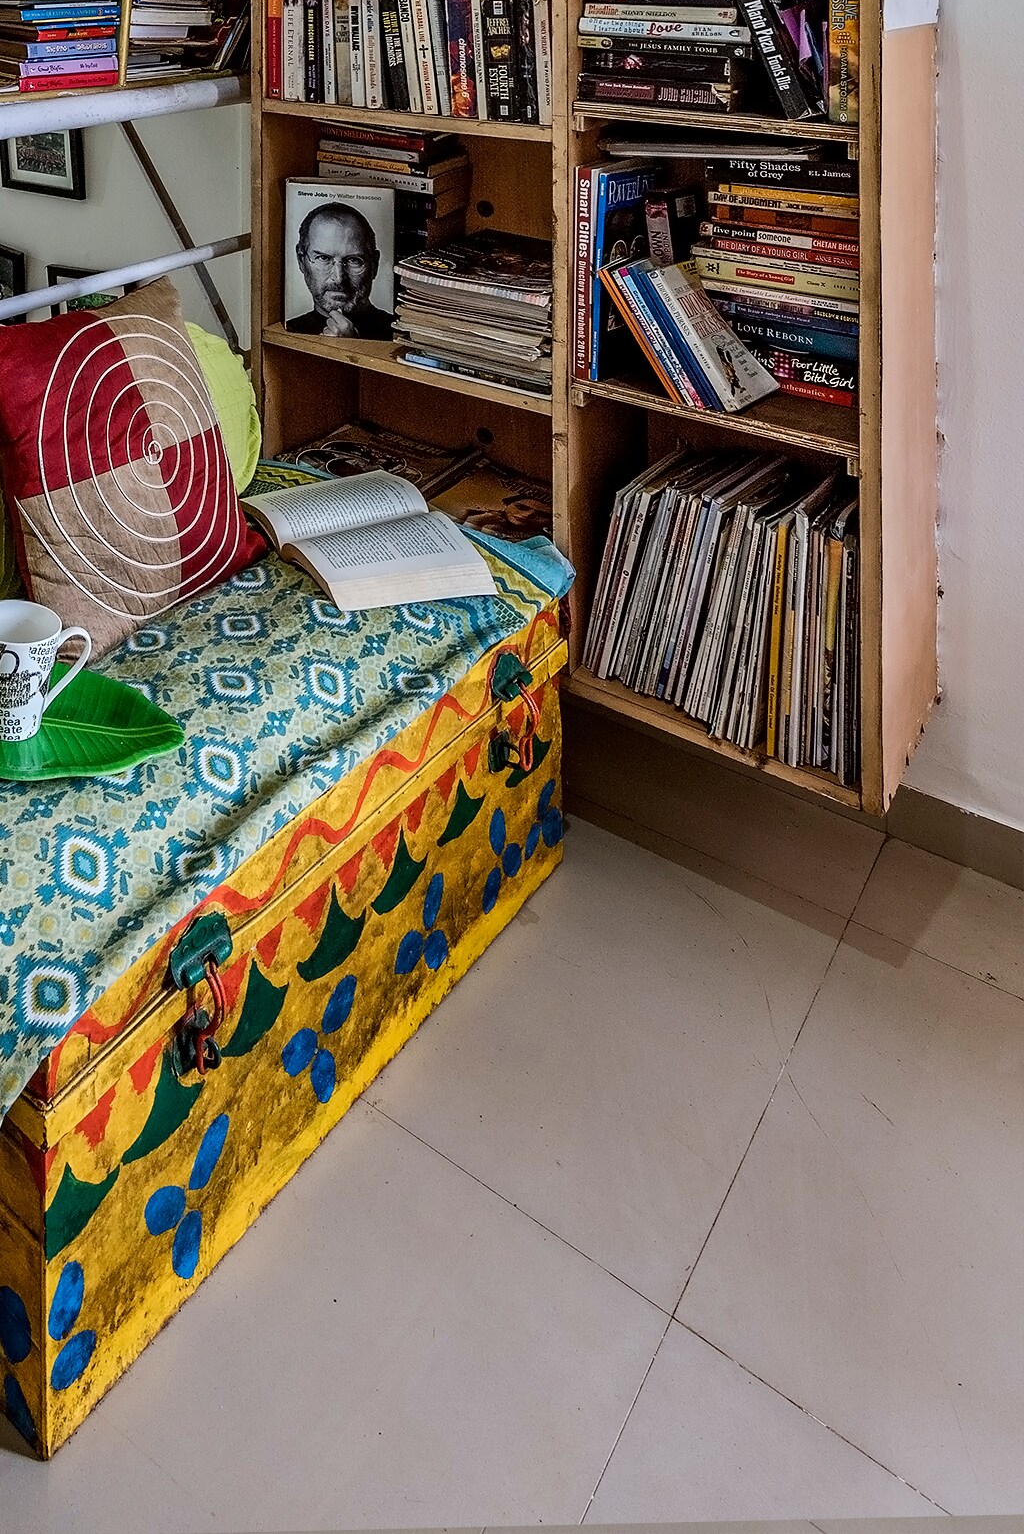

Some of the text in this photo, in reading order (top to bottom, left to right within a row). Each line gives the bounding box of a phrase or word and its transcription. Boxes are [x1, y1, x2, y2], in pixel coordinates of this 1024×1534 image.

[287, 9, 295, 27] LIFE
[621, 9, 644, 17] SIDNEY
[352, 26, 360, 52] WALLACE
[646, 22, 684, 36] love
[639, 41, 718, 54] JESUS FAMILY TOMB
[458, 38, 468, 90] chromosome
[488, 67, 500, 98] ESTATE
[498, 64, 510, 100] FOURTH
[839, 81, 849, 111] STORM
[729, 160, 802, 172] Fifty Shades
[748, 170, 784, 180] of Grey
[822, 170, 852, 179] James
[580, 178, 591, 218] Smart
[713, 193, 782, 209] DAY JUDGMENT
[578, 219, 591, 258] Cities
[713, 226, 837, 249] five point someone CHETAN
[717, 240, 730, 249] THE
[730, 242, 750, 252] DIARY
[751, 245, 761, 253] OF
[767, 247, 792, 259] YOUNG
[792, 250, 809, 261] GIRL
[579, 260, 587, 289] Directory
[577, 304, 586, 339] Yearbook
[737, 322, 814, 346] LOVE REBORN
[576, 339, 586, 370] 2016-17
[790, 358, 813, 371] Poor
[812, 361, 840, 376] Little
[779, 383, 826, 398] athematics
[803, 371, 855, 389] Bitch Girl
